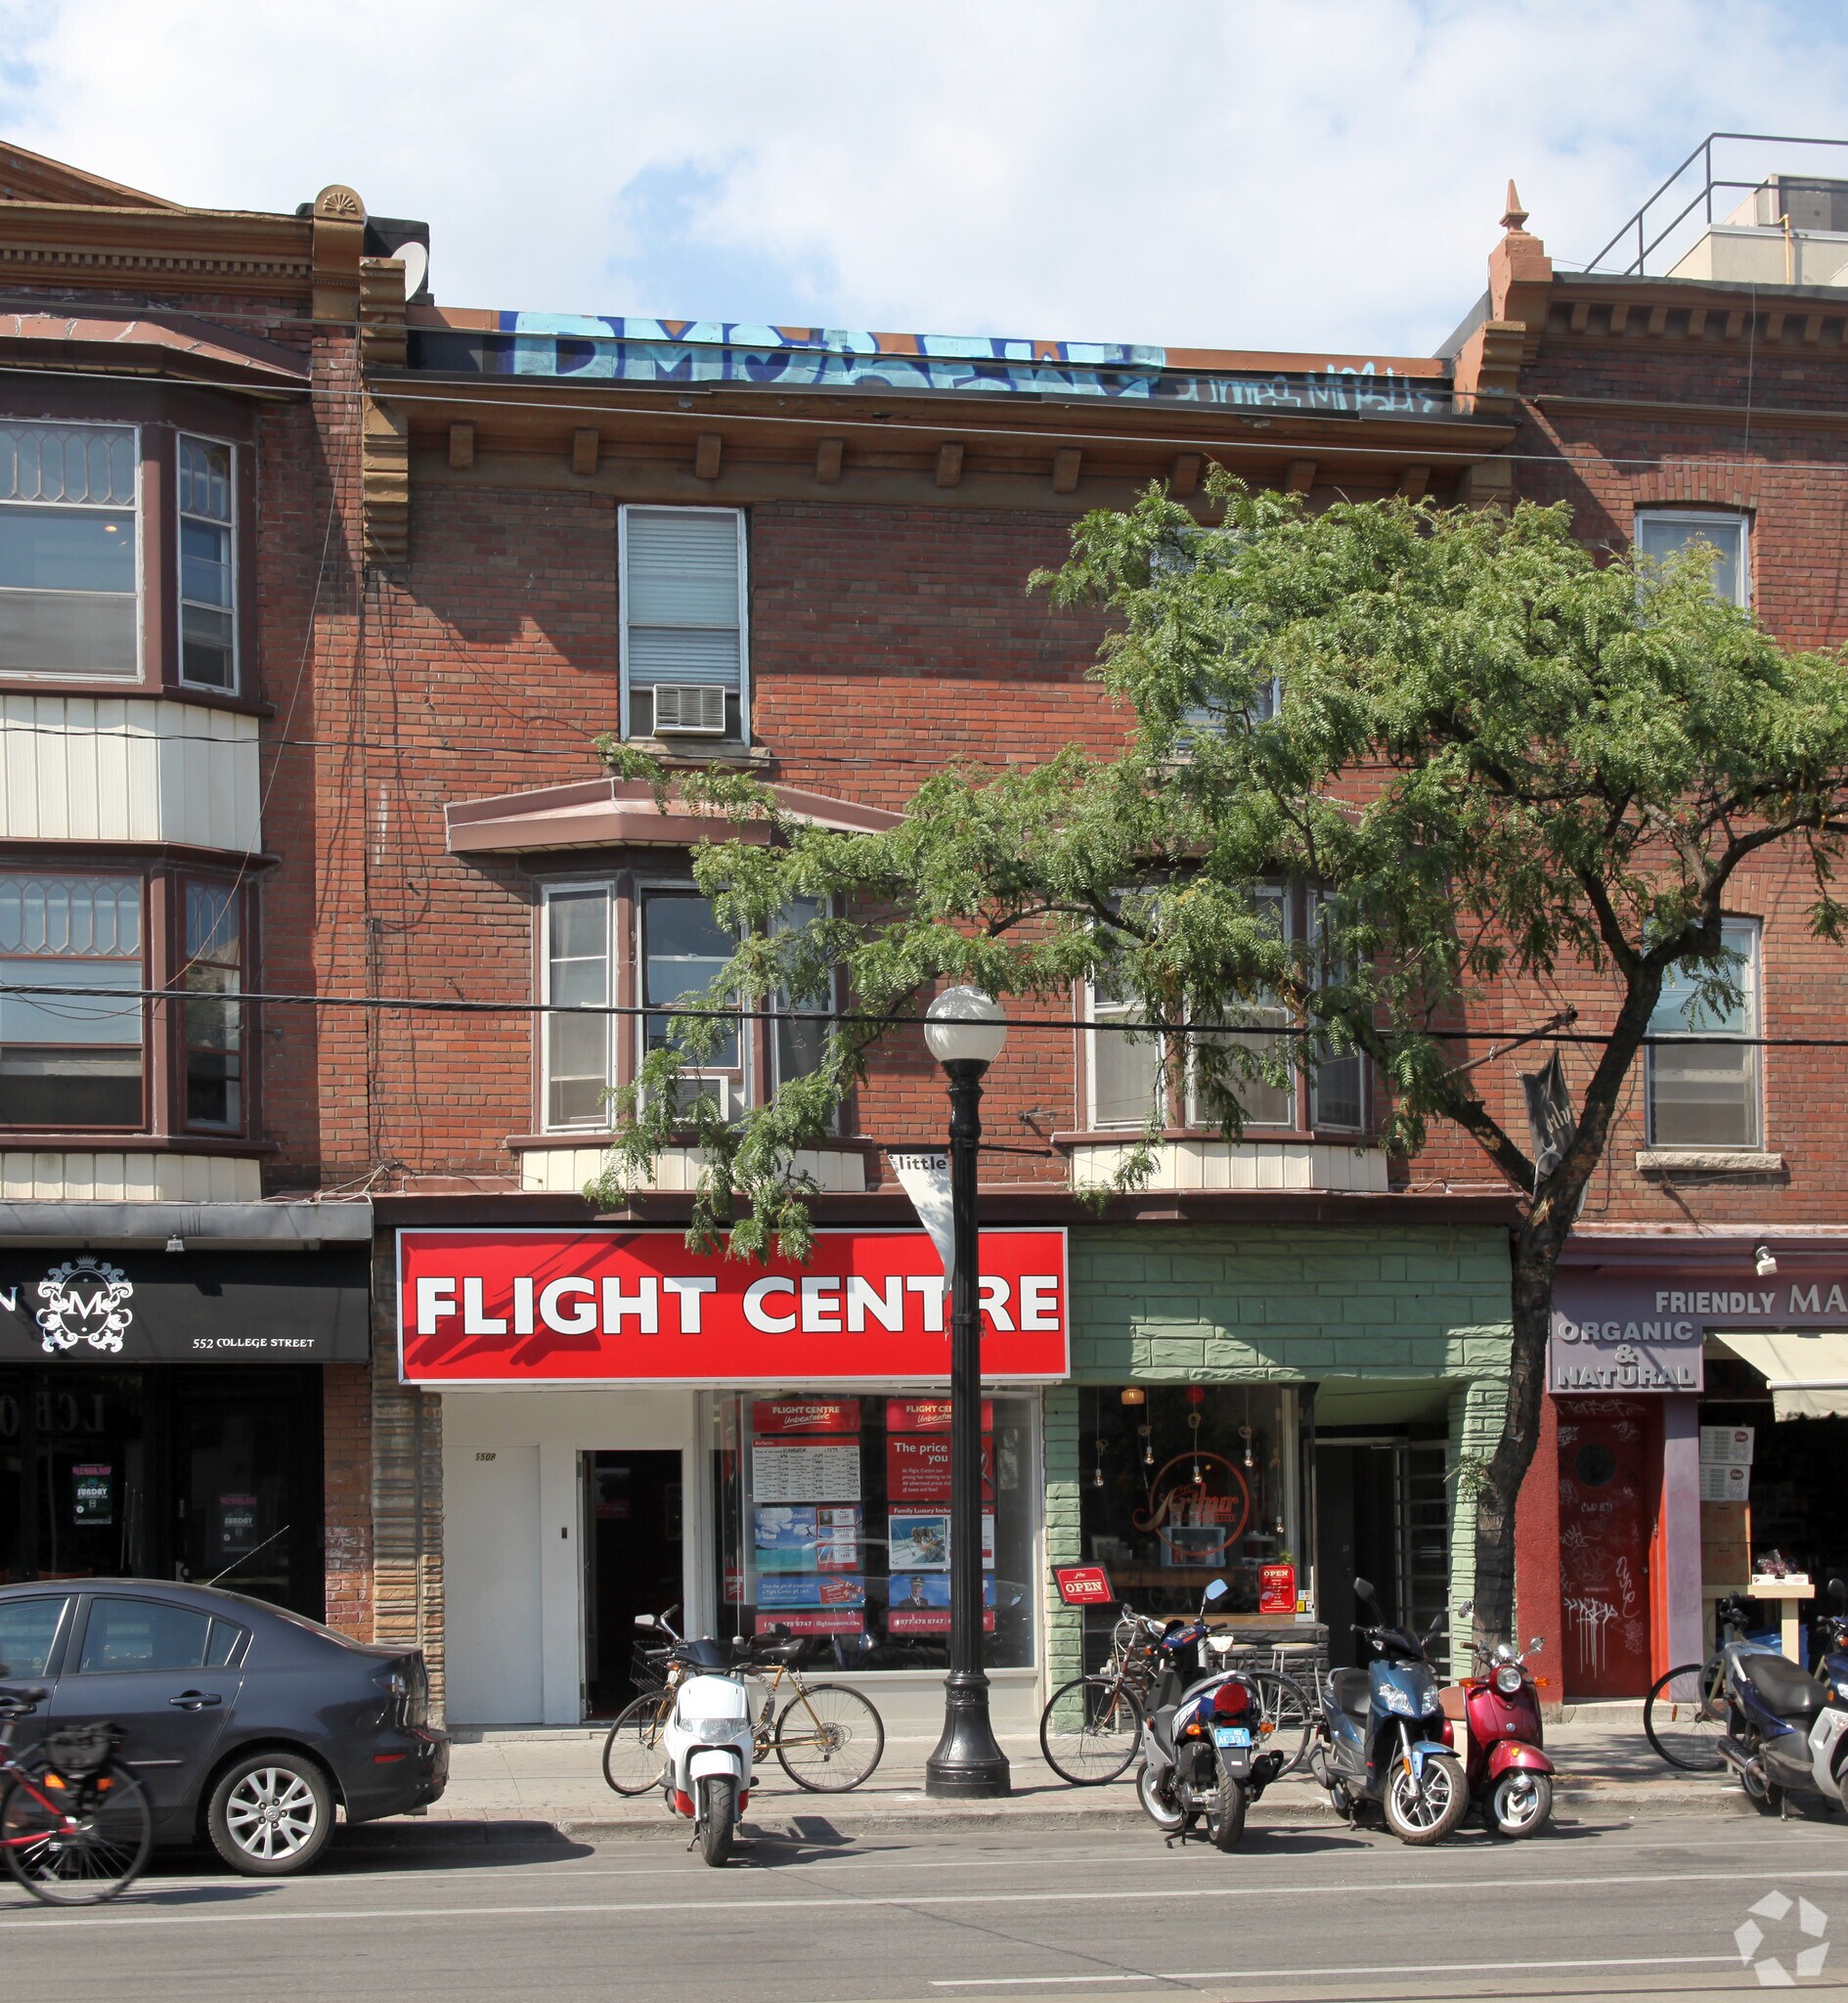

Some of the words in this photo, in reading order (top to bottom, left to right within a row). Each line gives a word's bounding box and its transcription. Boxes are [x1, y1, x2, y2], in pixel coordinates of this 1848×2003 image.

[899, 1156, 947, 1170] little
[65, 1290, 108, 1320] M
[416, 1275, 718, 1336] FLIGHT
[741, 1274, 1060, 1334] CENTRE
[1655, 1291, 1776, 1313] FRIENDLY
[1558, 1321, 1694, 1342] ORGANIC
[192, 1338, 214, 1350] 552
[216, 1338, 268, 1349] COLLEGE
[270, 1338, 315, 1348] STREET
[1614, 1343, 1638, 1364] &
[1558, 1366, 1695, 1387] NATURAL
[894, 1443, 916, 1452] The
[920, 1443, 947, 1454] price
[928, 1454, 948, 1465] you
[1066, 1581, 1103, 1593] OPEN
[1218, 1735, 1246, 1745] AC331
